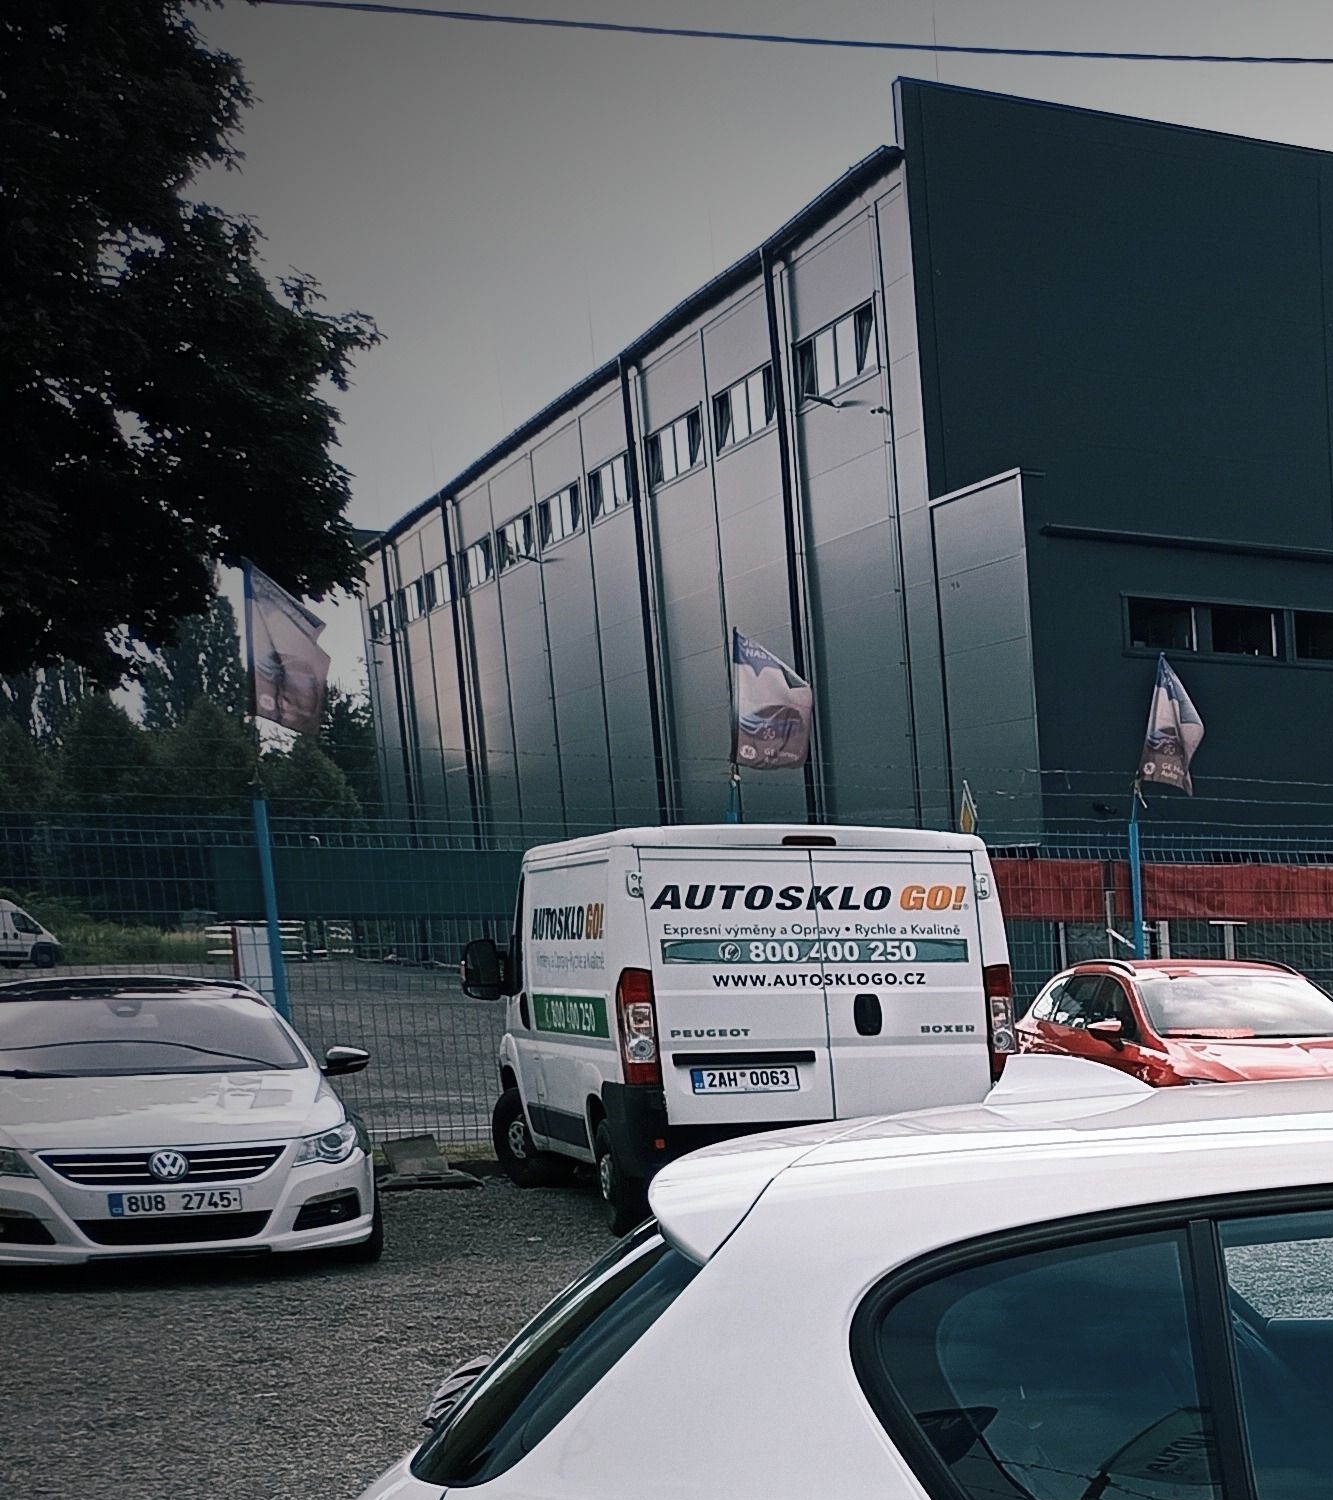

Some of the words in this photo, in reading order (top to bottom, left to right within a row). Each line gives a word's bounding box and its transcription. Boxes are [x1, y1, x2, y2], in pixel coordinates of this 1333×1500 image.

[650, 884, 892, 911] AUTOSKLO
[900, 885, 967, 911] GO!
[532, 905, 585, 940] AUTOSKLO
[586, 903, 604, 940] GO!
[664, 923, 721, 937] Expresní
[725, 923, 776, 937] výměny
[780, 927, 788, 935] a
[791, 923, 841, 937] Opravy
[855, 923, 897, 937] Rychle
[900, 927, 907, 935] a
[911, 923, 961, 936] Kvalitně
[750, 941, 799, 962] 800
[810, 941, 860, 962] 400
[867, 940, 917, 961] 250
[713, 972, 926, 987] WWW.AUTOSKLOGO.CZ
[551, 1001, 566, 1029] 800
[566, 1000, 580, 1030] 400
[580, 1002, 596, 1032] 250
[670, 1028, 751, 1038] PEUGEOT
[920, 1024, 975, 1034] BOXER
[706, 1072, 738, 1088] 2AH
[750, 1070, 790, 1086] 0063
[127, 1195, 166, 1213] 8U8
[181, 1191, 232, 1211] 2745
